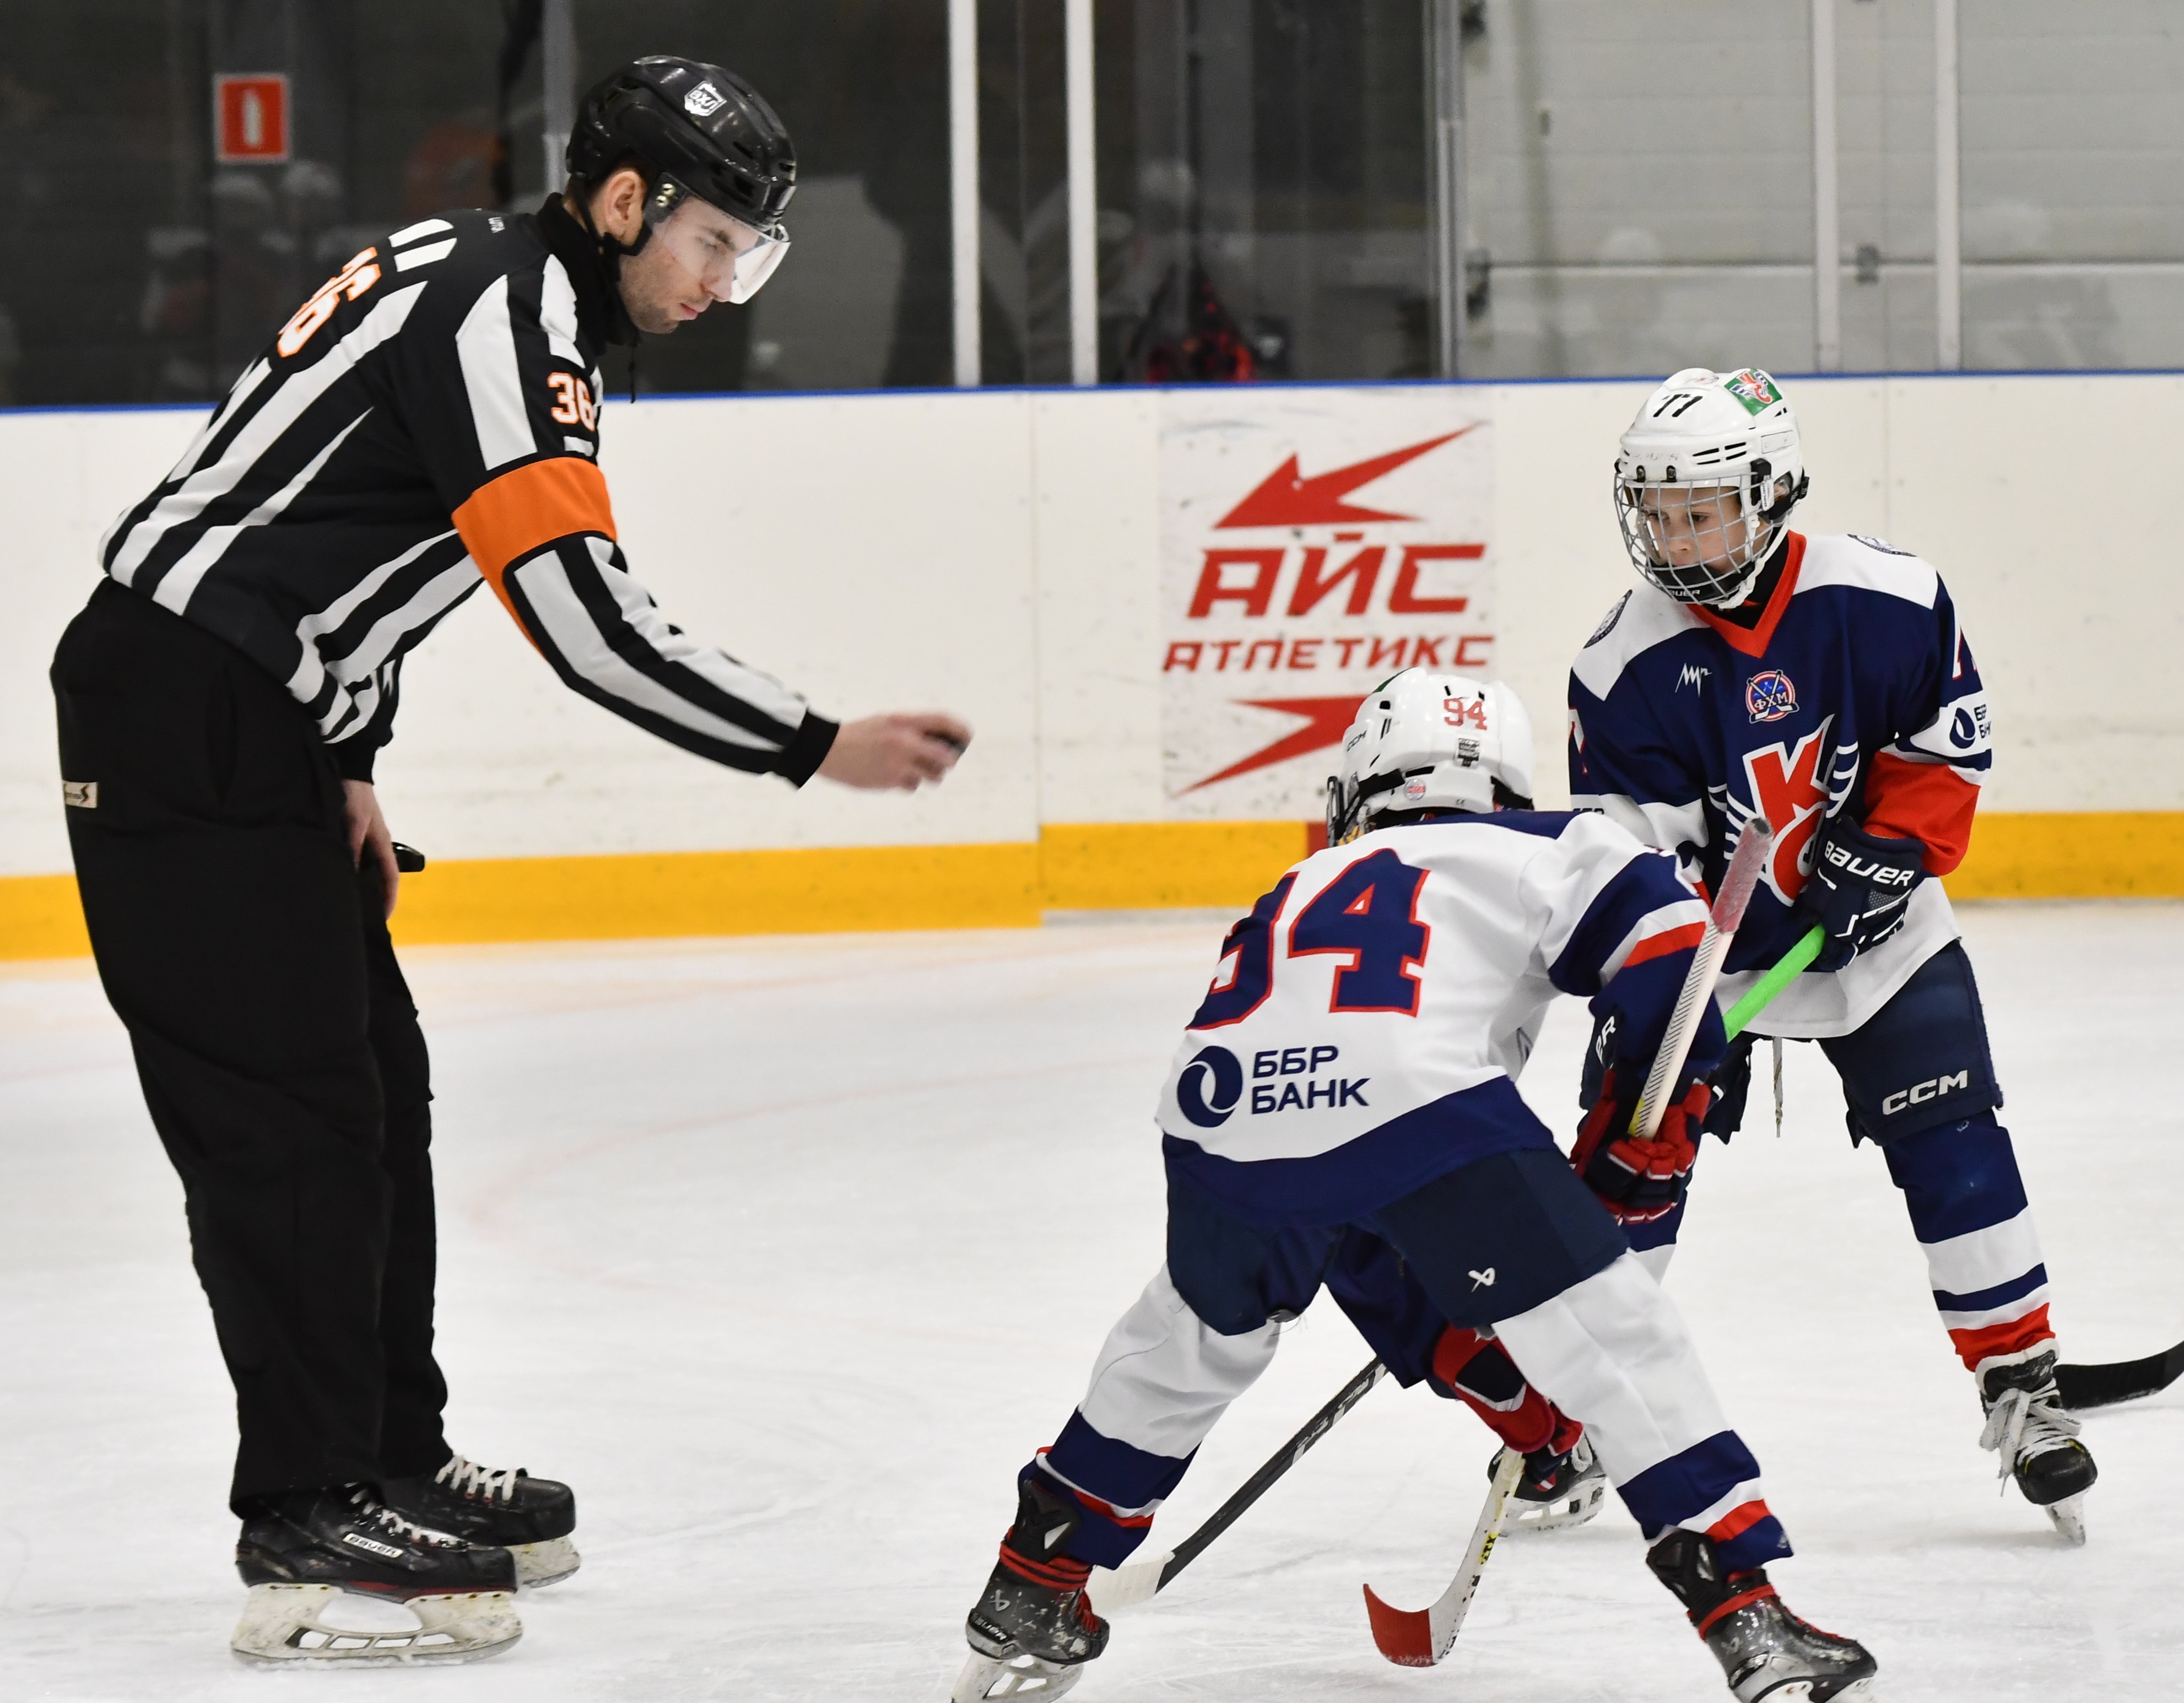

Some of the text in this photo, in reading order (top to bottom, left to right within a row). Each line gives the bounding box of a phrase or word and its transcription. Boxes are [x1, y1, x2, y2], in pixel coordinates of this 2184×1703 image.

[547, 371, 596, 432] 36
[1652, 393, 1704, 418] 77
[1187, 532, 1486, 618] АЙС
[1162, 635, 1495, 673] АТЛЕТИКС
[1444, 698, 1488, 731] 94
[1754, 691, 1788, 711] ФХМ
[1824, 840, 1915, 886] BAUER
[1185, 847, 1431, 1030] 94
[1252, 1045, 1339, 1078] ББР
[1251, 1077, 1371, 1115] БАНК
[1882, 1069, 1968, 1116] CCM
